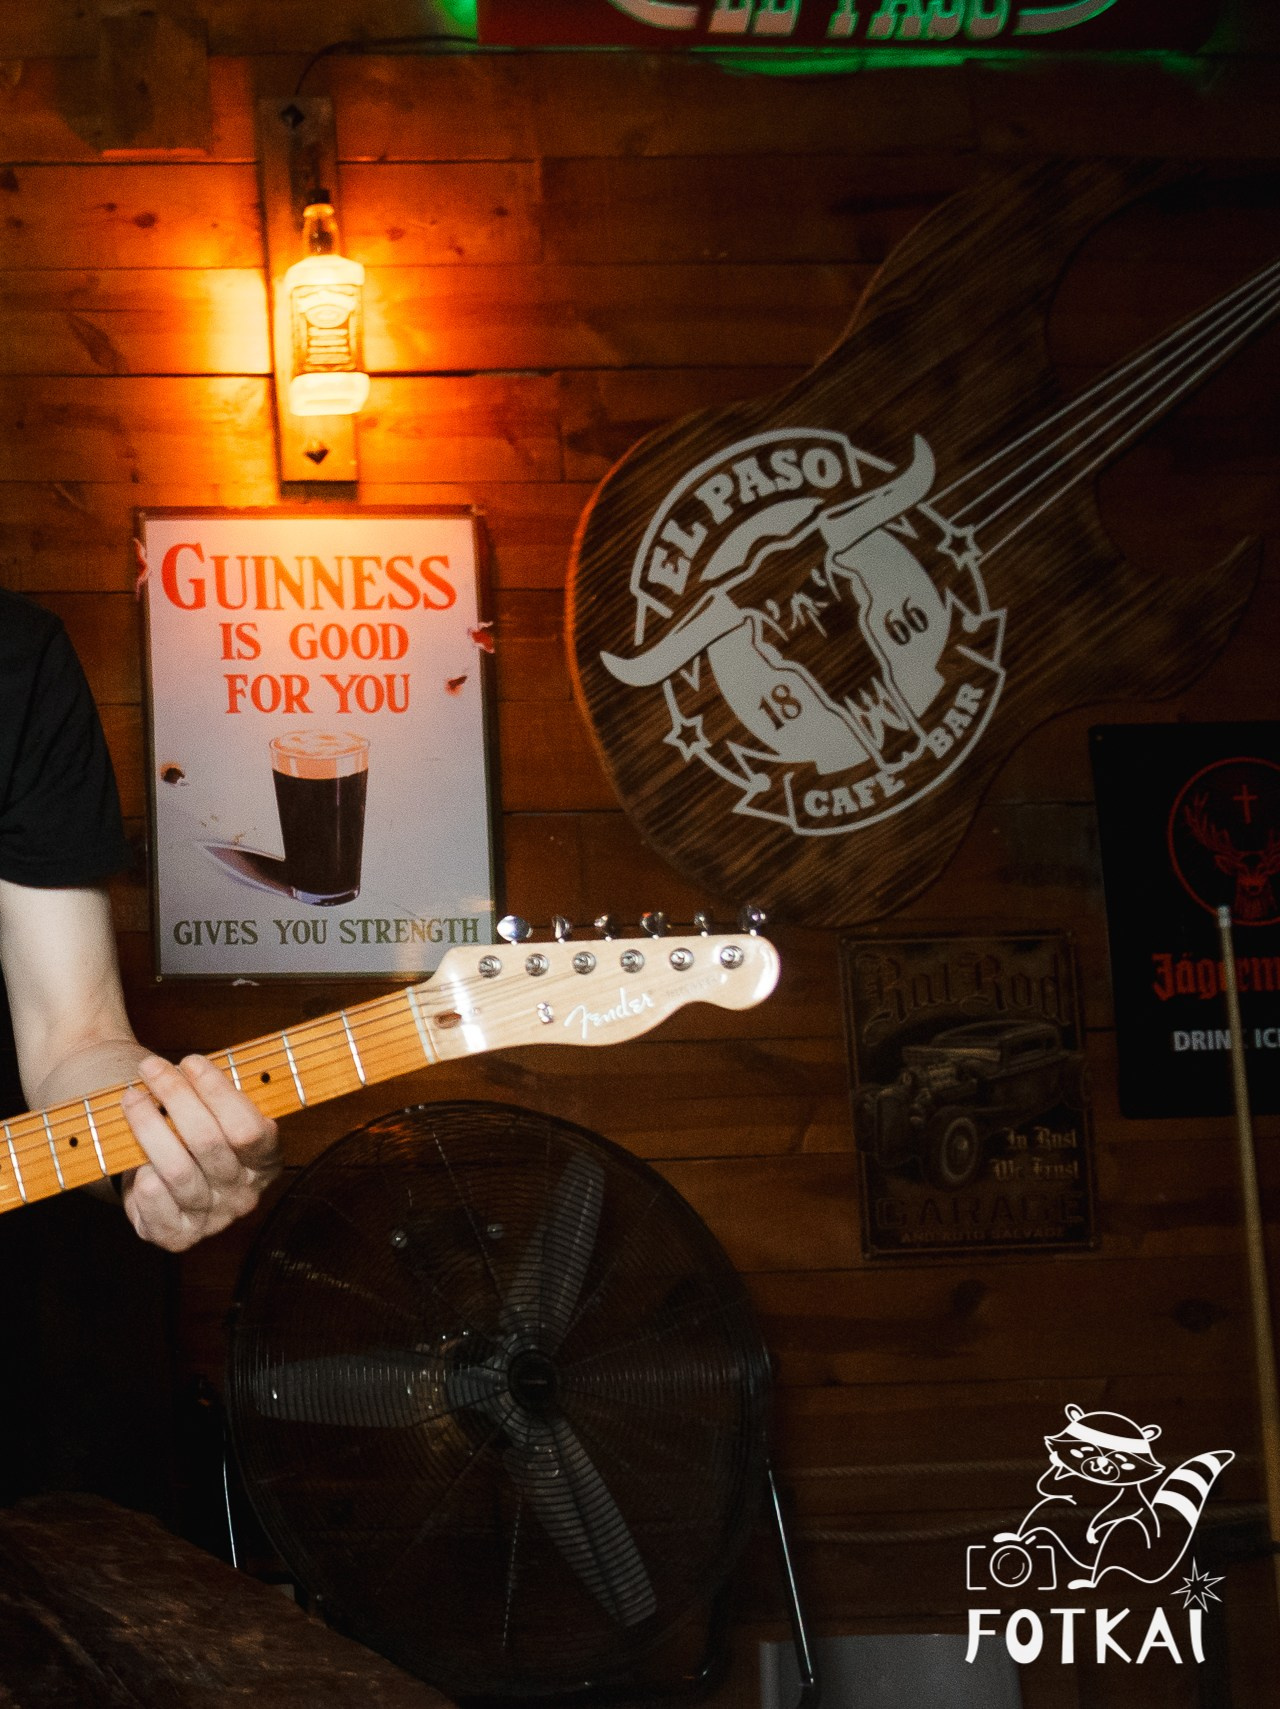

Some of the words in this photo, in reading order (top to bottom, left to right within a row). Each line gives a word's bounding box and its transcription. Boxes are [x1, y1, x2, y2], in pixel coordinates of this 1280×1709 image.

[648, 518, 709, 595] EL
[695, 448, 843, 523] PASO
[161, 542, 457, 611] GUINNESS
[220, 622, 261, 660] IS
[289, 622, 409, 660] GOOD
[884, 597, 928, 647] 66
[224, 674, 311, 714] FOR
[320, 673, 410, 714] YOU
[758, 683, 802, 732] 18
[925, 683, 985, 758] BAR
[173, 920, 258, 945] GIVES
[273, 919, 327, 945] YOU
[339, 918, 479, 944] STRENGTH
[564, 987, 654, 1040] Fender
[1173, 1028, 1249, 1052] DRIN
